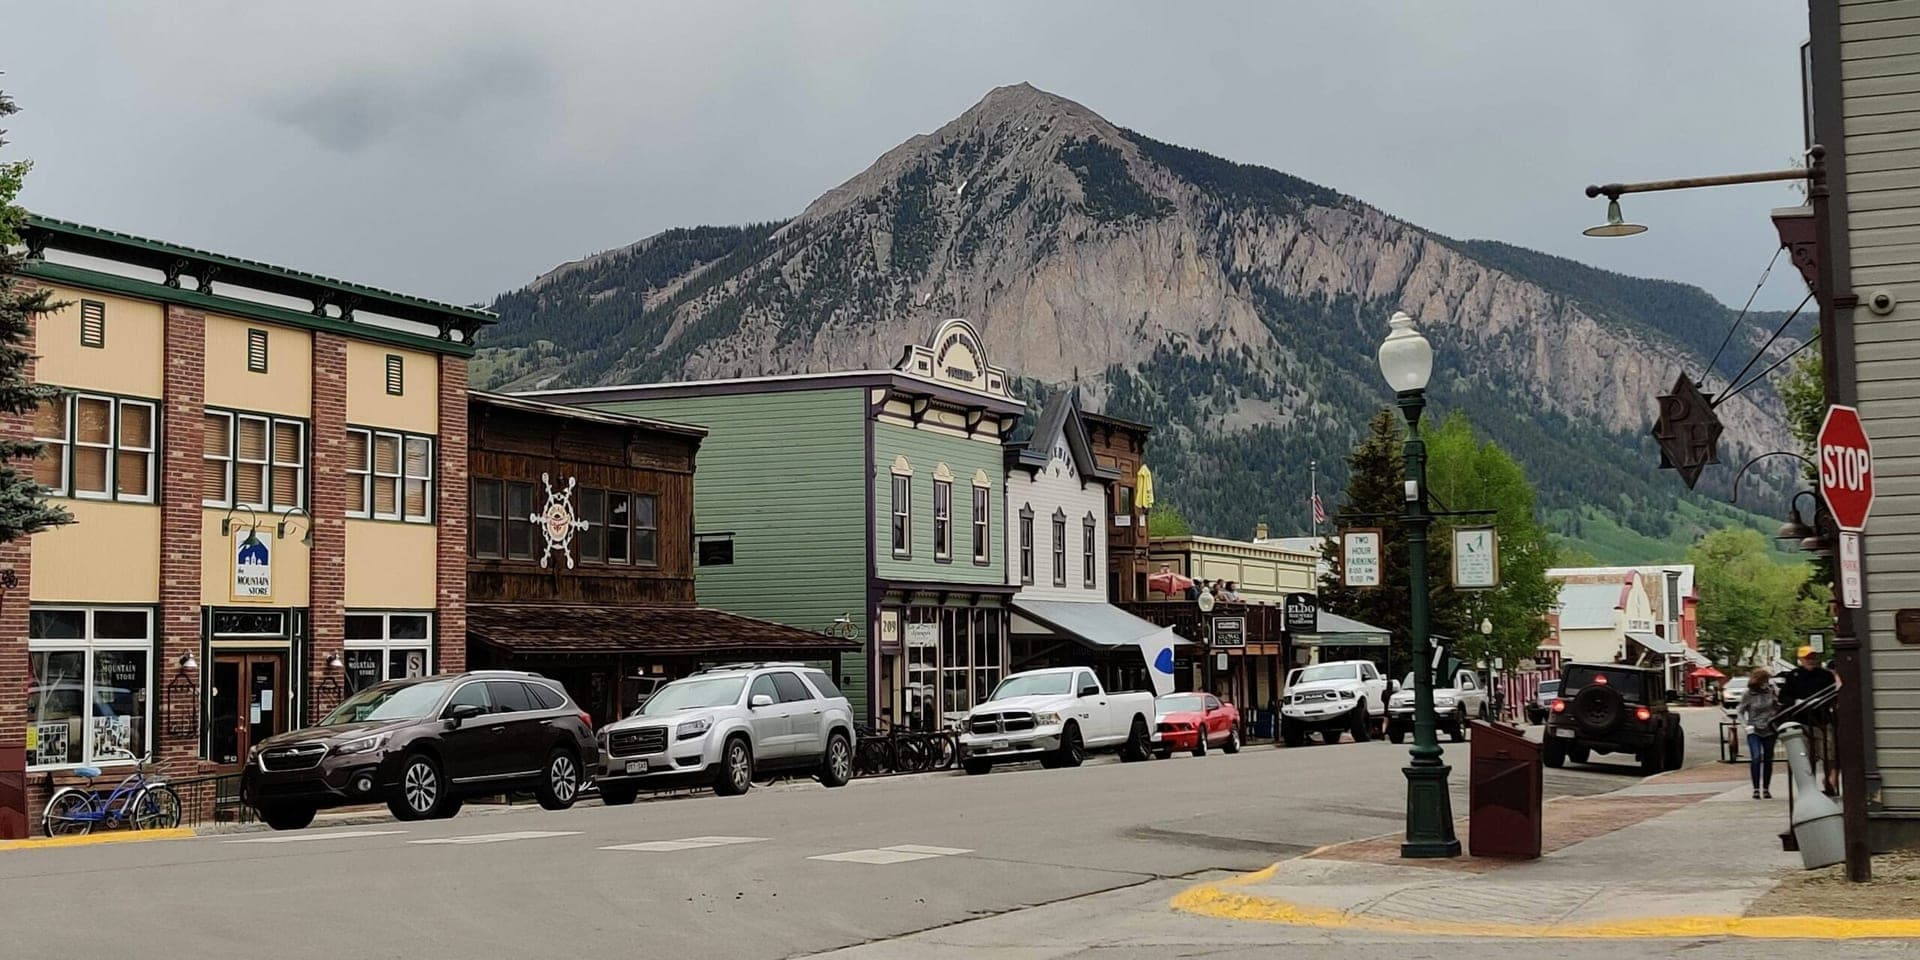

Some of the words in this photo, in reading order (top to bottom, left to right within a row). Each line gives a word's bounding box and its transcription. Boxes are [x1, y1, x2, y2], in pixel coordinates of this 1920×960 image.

[1823, 444, 1869, 491] STOP
[1354, 536, 1368, 544] TWO
[1352, 546, 1371, 555] HOUR
[1347, 557, 1376, 565] PARKING
[238, 575, 269, 586] MOUNTAIN
[248, 587, 268, 595] STORE
[1288, 604, 1315, 613] ELDO
[883, 620, 897, 633] 209
[102, 663, 136, 672] MOUNTAIN
[348, 661, 376, 669] MOUNTAIN
